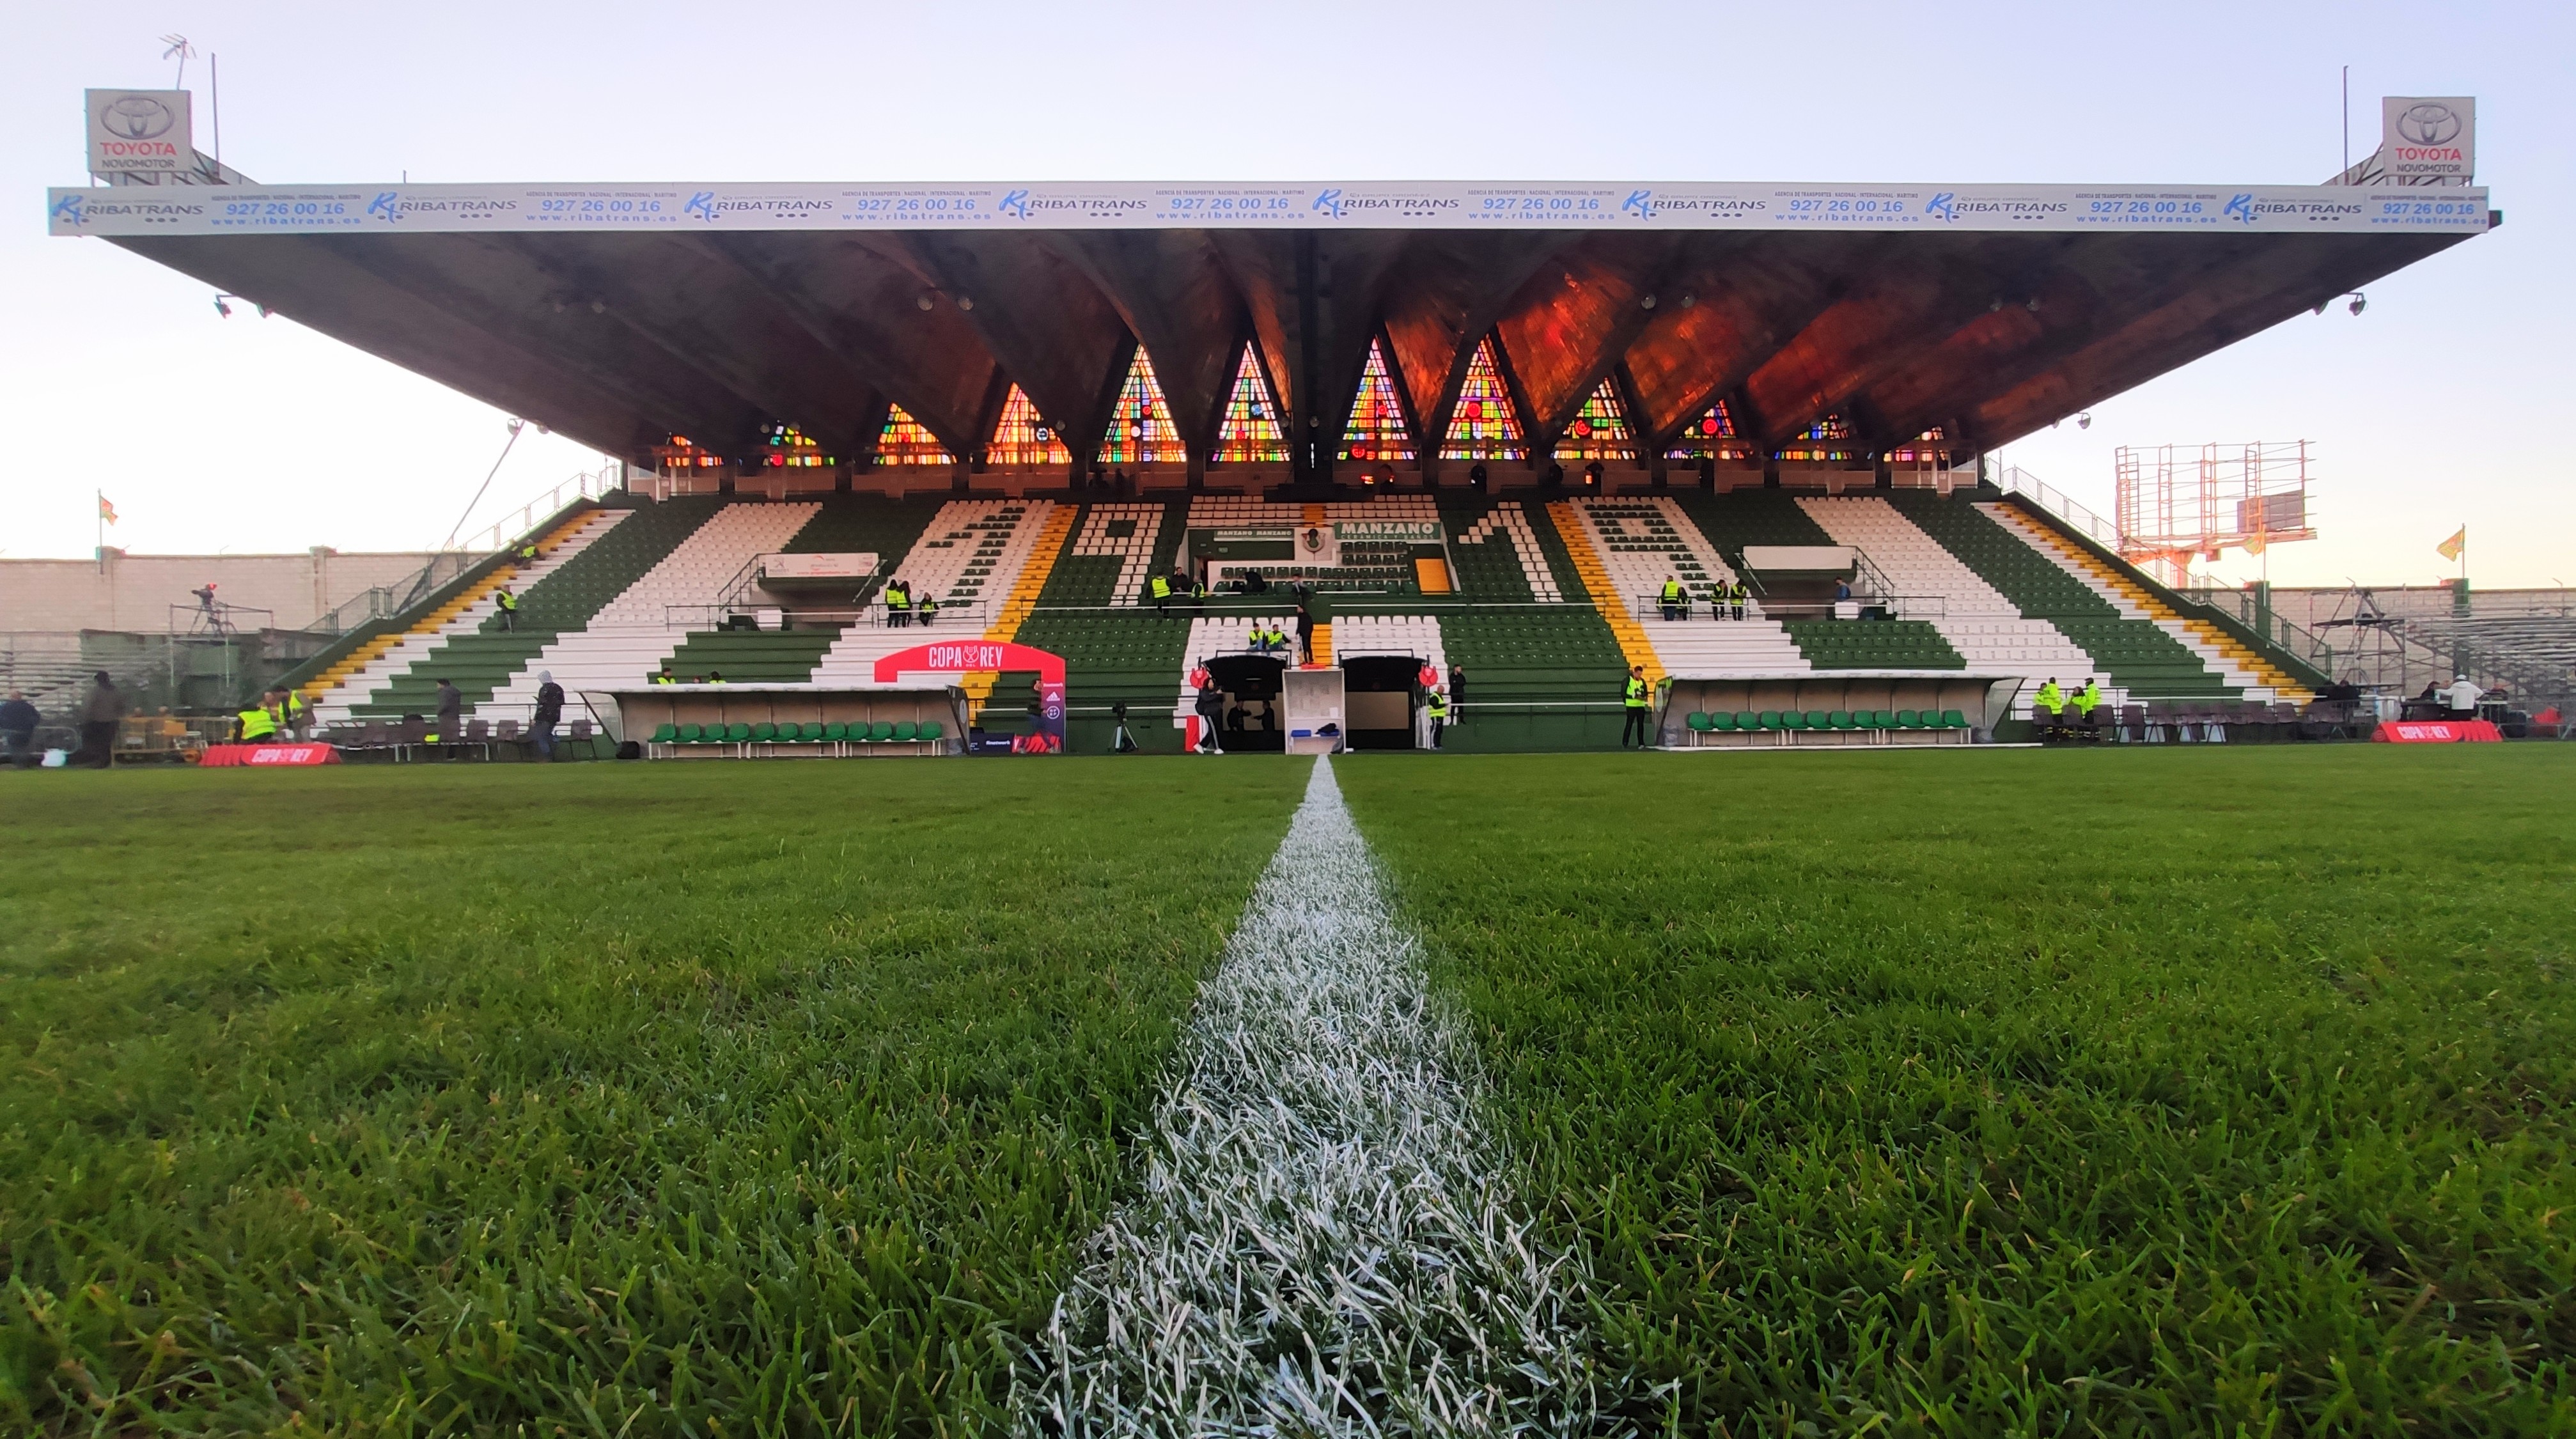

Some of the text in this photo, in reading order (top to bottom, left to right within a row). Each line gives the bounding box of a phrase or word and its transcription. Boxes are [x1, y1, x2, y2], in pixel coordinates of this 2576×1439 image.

[100, 142, 176, 156] TOYOTA
[2395, 147, 2462, 161] TOYOTA
[102, 159, 175, 168] NOVOMOTOR
[2397, 164, 2461, 173] NOVOMOTOR
[226, 203, 345, 215] 927 26 00 16
[399, 201, 517, 211] RIBATRANS
[542, 199, 660, 212] 927 26 00 16
[716, 201, 834, 211] RIBATRANS
[857, 199, 976, 210] 927 26 00 16
[1030, 200, 1148, 209] RIBATRANS
[1171, 198, 1289, 210] 927 26 00 16
[1343, 199, 1460, 208] RIBATRANS
[1483, 198, 1599, 210] 927 26 00 16
[1653, 200, 1767, 210] RIBATRANS
[1790, 200, 1903, 212] 927 26 00 16
[1955, 203, 2068, 212] RIBATRANS
[2091, 201, 2203, 214] 927 26 00 16
[2253, 204, 2362, 214] RIBATRANS
[2383, 203, 2474, 215] 927 26 00 16
[84, 205, 204, 215] RIBATRANS
[211, 217, 361, 225] www.ribatrans.es
[1775, 214, 1919, 222] www.ribatrans.es
[2076, 215, 2217, 223] www.ribatrans.es
[1341, 523, 1434, 534] MANZANO
[928, 646, 962, 667] COPA
[980, 646, 1003, 667] REY
[2396, 726, 2451, 739] COPA REY
[251, 749, 314, 762] COPA REY
